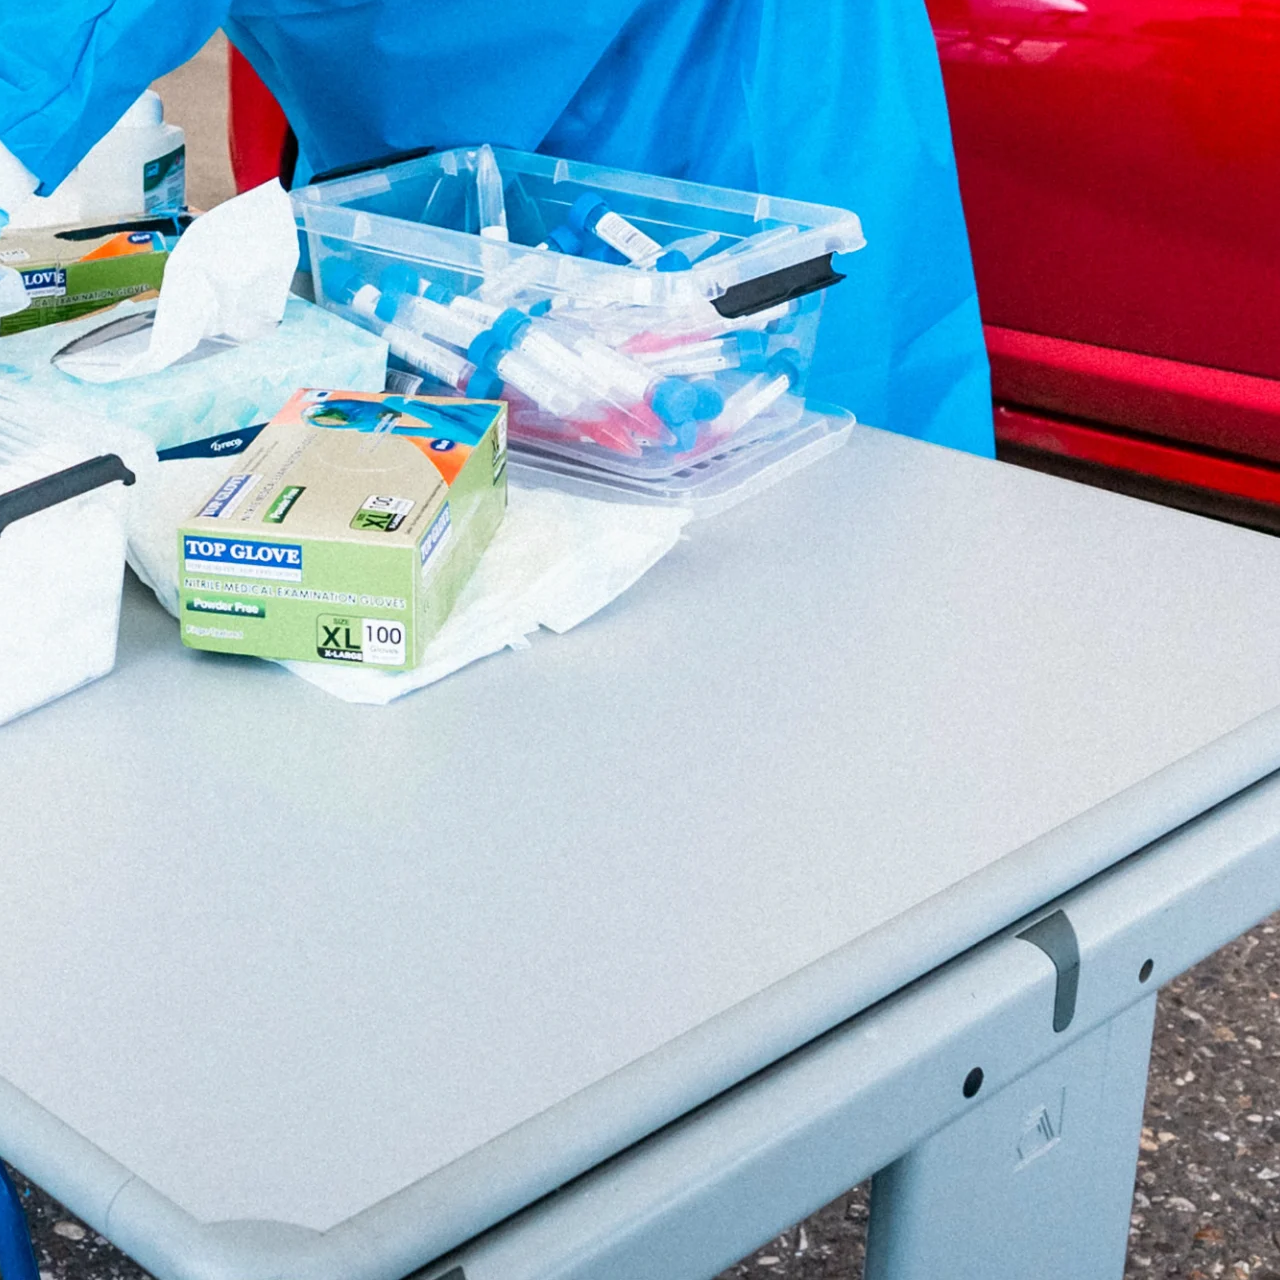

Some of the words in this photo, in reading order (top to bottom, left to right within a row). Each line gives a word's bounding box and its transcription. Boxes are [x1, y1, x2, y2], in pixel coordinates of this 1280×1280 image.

[24, 271, 65, 286] LOVE
[362, 512, 393, 529] XL
[185, 540, 227, 557] TOP
[229, 544, 301, 565] GLOVE
[185, 579, 220, 591] NITRILE
[224, 583, 274, 597] MEDICAL
[277, 587, 356, 604] EXAMINATION
[360, 595, 406, 609] GLOVES
[193, 597, 233, 612] Powder
[234, 601, 259, 615] Free
[322, 625, 361, 650] XL
[366, 625, 402, 645] 100
[324, 649, 362, 661] X-LARGE
